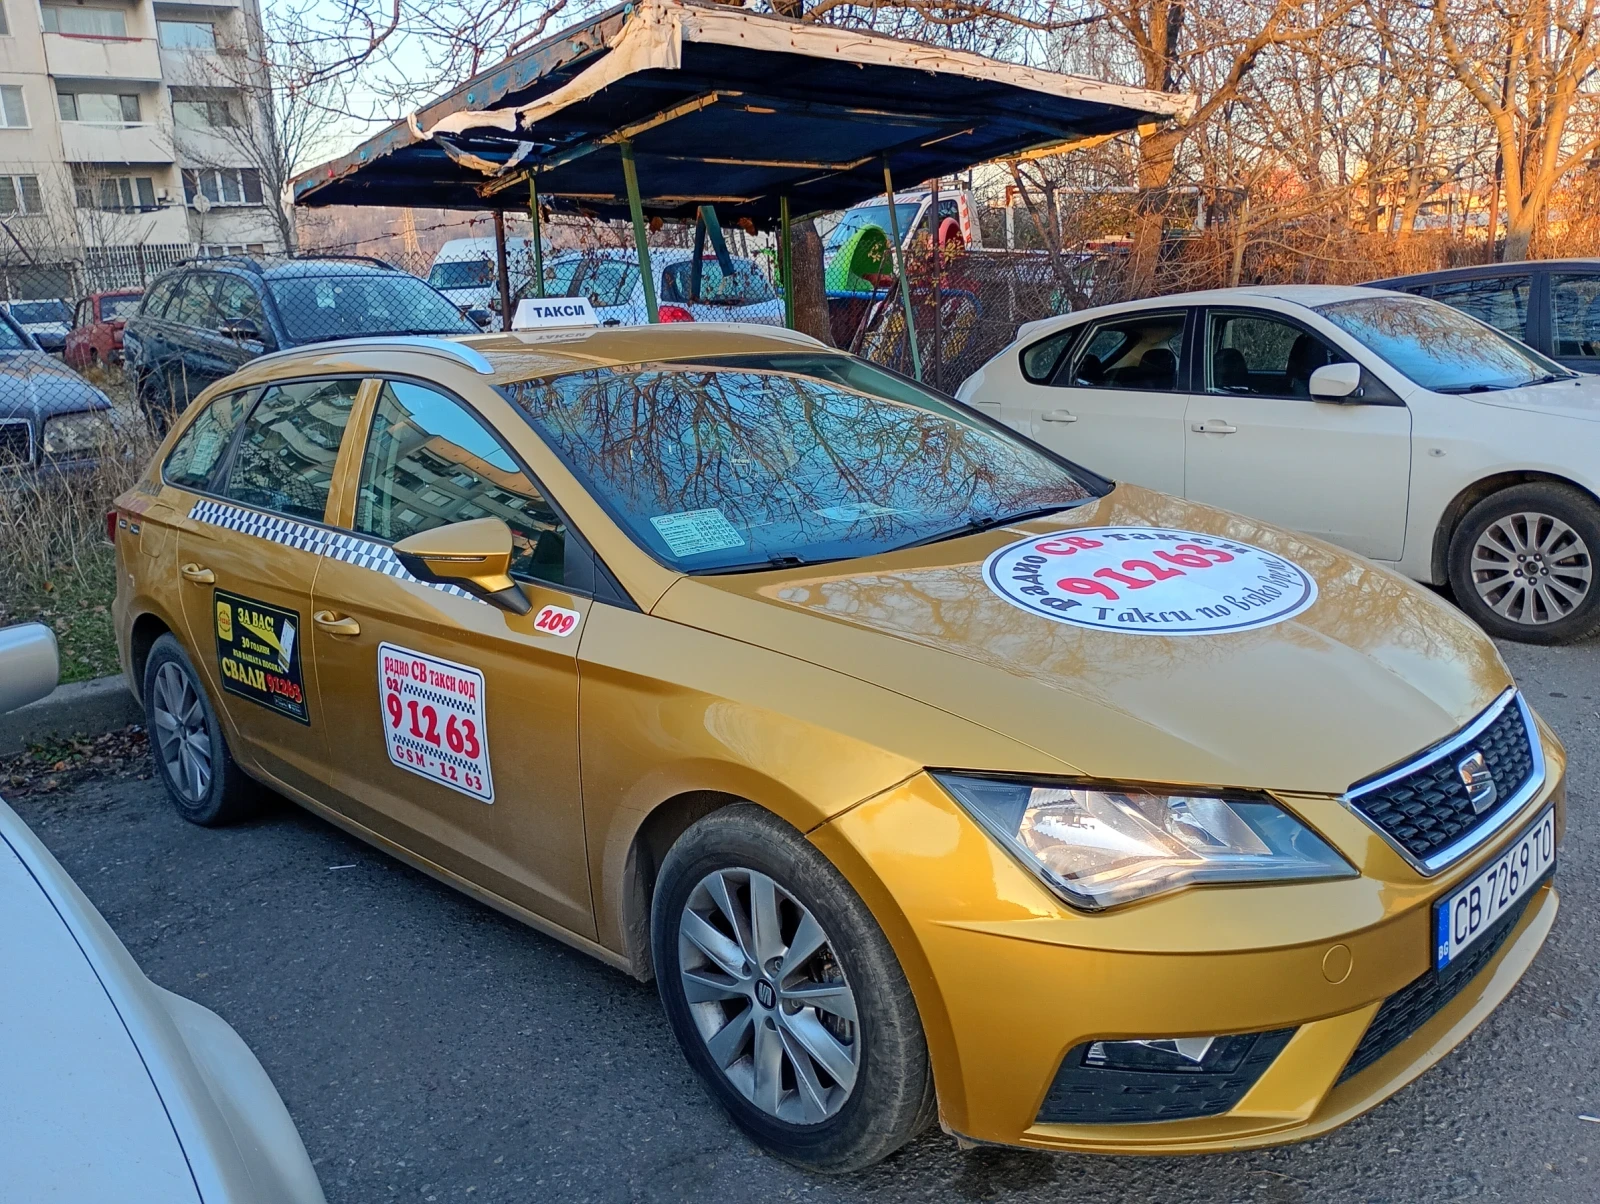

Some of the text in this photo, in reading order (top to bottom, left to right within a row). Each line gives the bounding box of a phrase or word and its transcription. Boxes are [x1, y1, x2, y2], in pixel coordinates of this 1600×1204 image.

[533, 305, 585, 318] ТАКСИ
[1034, 536, 1104, 555] СВ
[1056, 544, 1235, 601] 91263
[237, 607, 251, 626] ЗА
[251, 612, 274, 633] ВАС!
[536, 609, 575, 633] 209
[1195, 604, 1231, 619] по
[241, 636, 250, 648] 30
[222, 657, 303, 703] СВАЛИ 91263
[384, 656, 409, 678] радио
[411, 660, 428, 684] СВ
[429, 670, 456, 692] такси
[396, 745, 426, 768] GSM
[1485, 842, 1529, 920] 7269
[1438, 941, 1449, 961] BG
